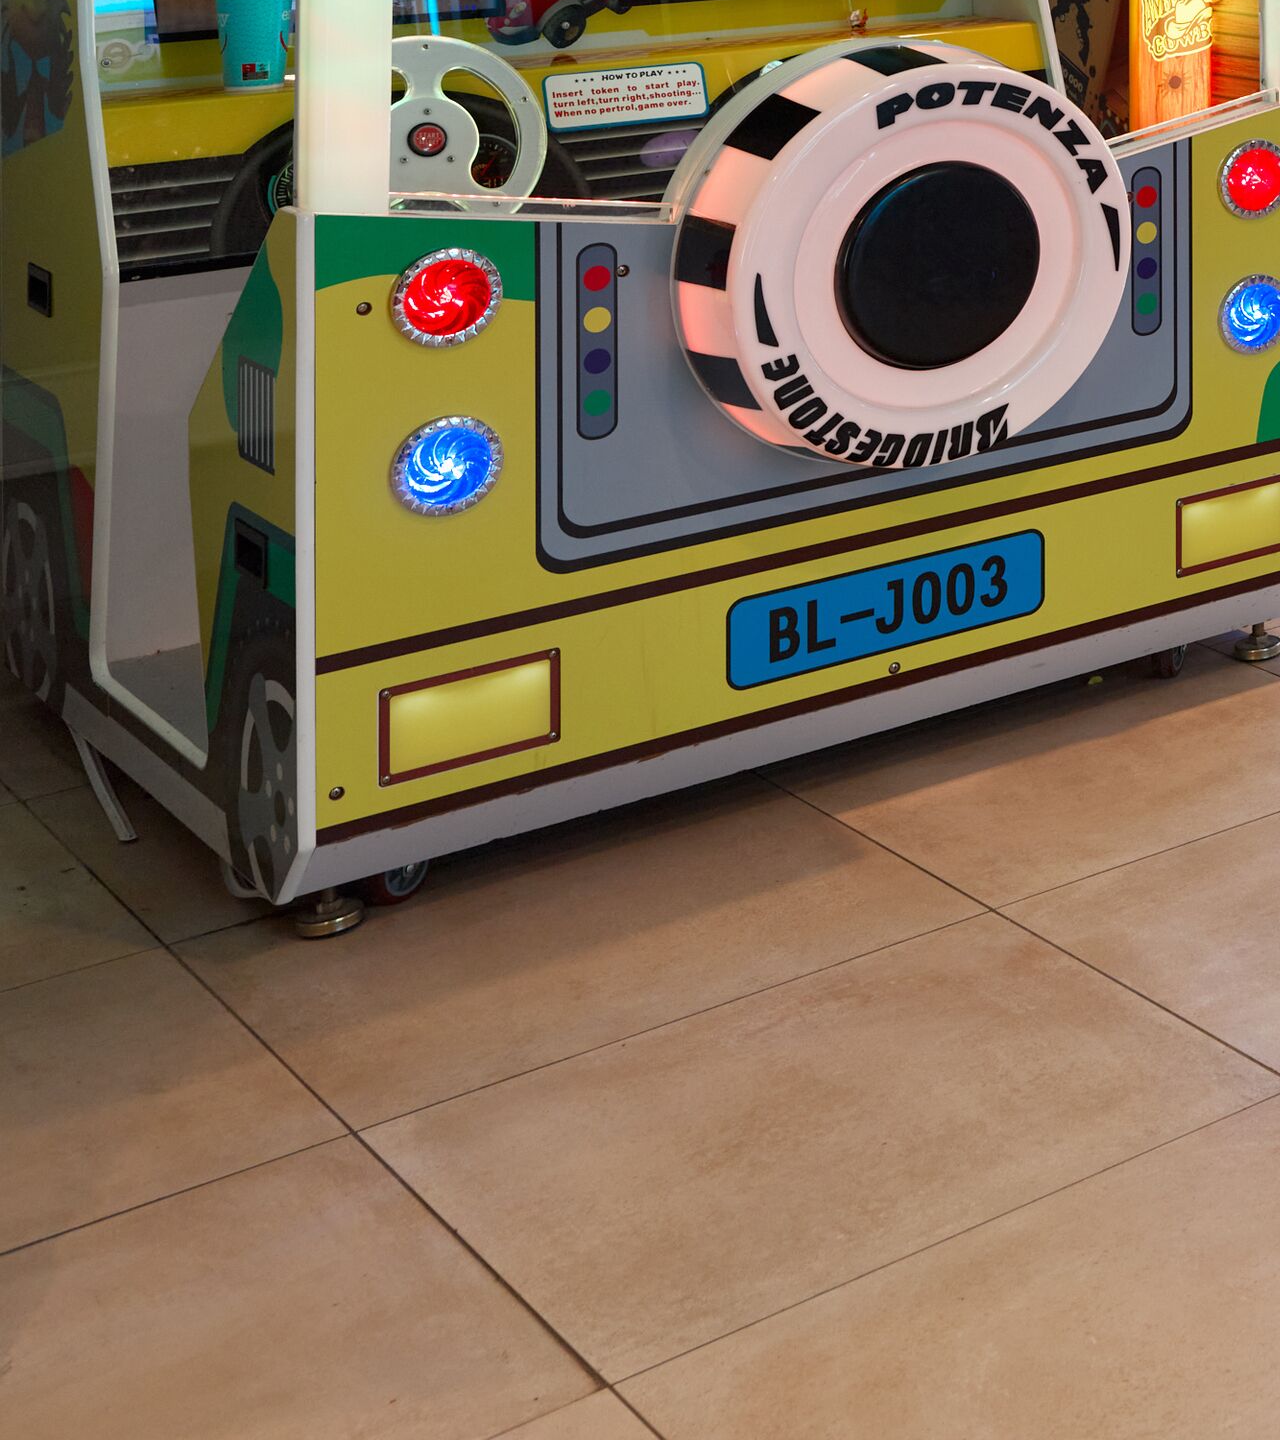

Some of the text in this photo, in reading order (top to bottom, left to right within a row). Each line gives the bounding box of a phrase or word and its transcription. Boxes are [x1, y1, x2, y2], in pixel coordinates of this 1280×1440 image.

[602, 73, 623, 81] HOW
[640, 70, 663, 78] PLAY
[552, 90, 583, 99] Insert
[591, 86, 619, 95] token
[645, 81, 669, 90] start
[677, 79, 700, 88] play.
[553, 100, 575, 108] turn
[554, 110, 582, 118] When
[667, 99, 692, 107] over.
[876, 81, 1108, 194] POTENZA
[761, 354, 1010, 469] BRIDGESTONE
[769, 555, 1009, 664] BL-J003
